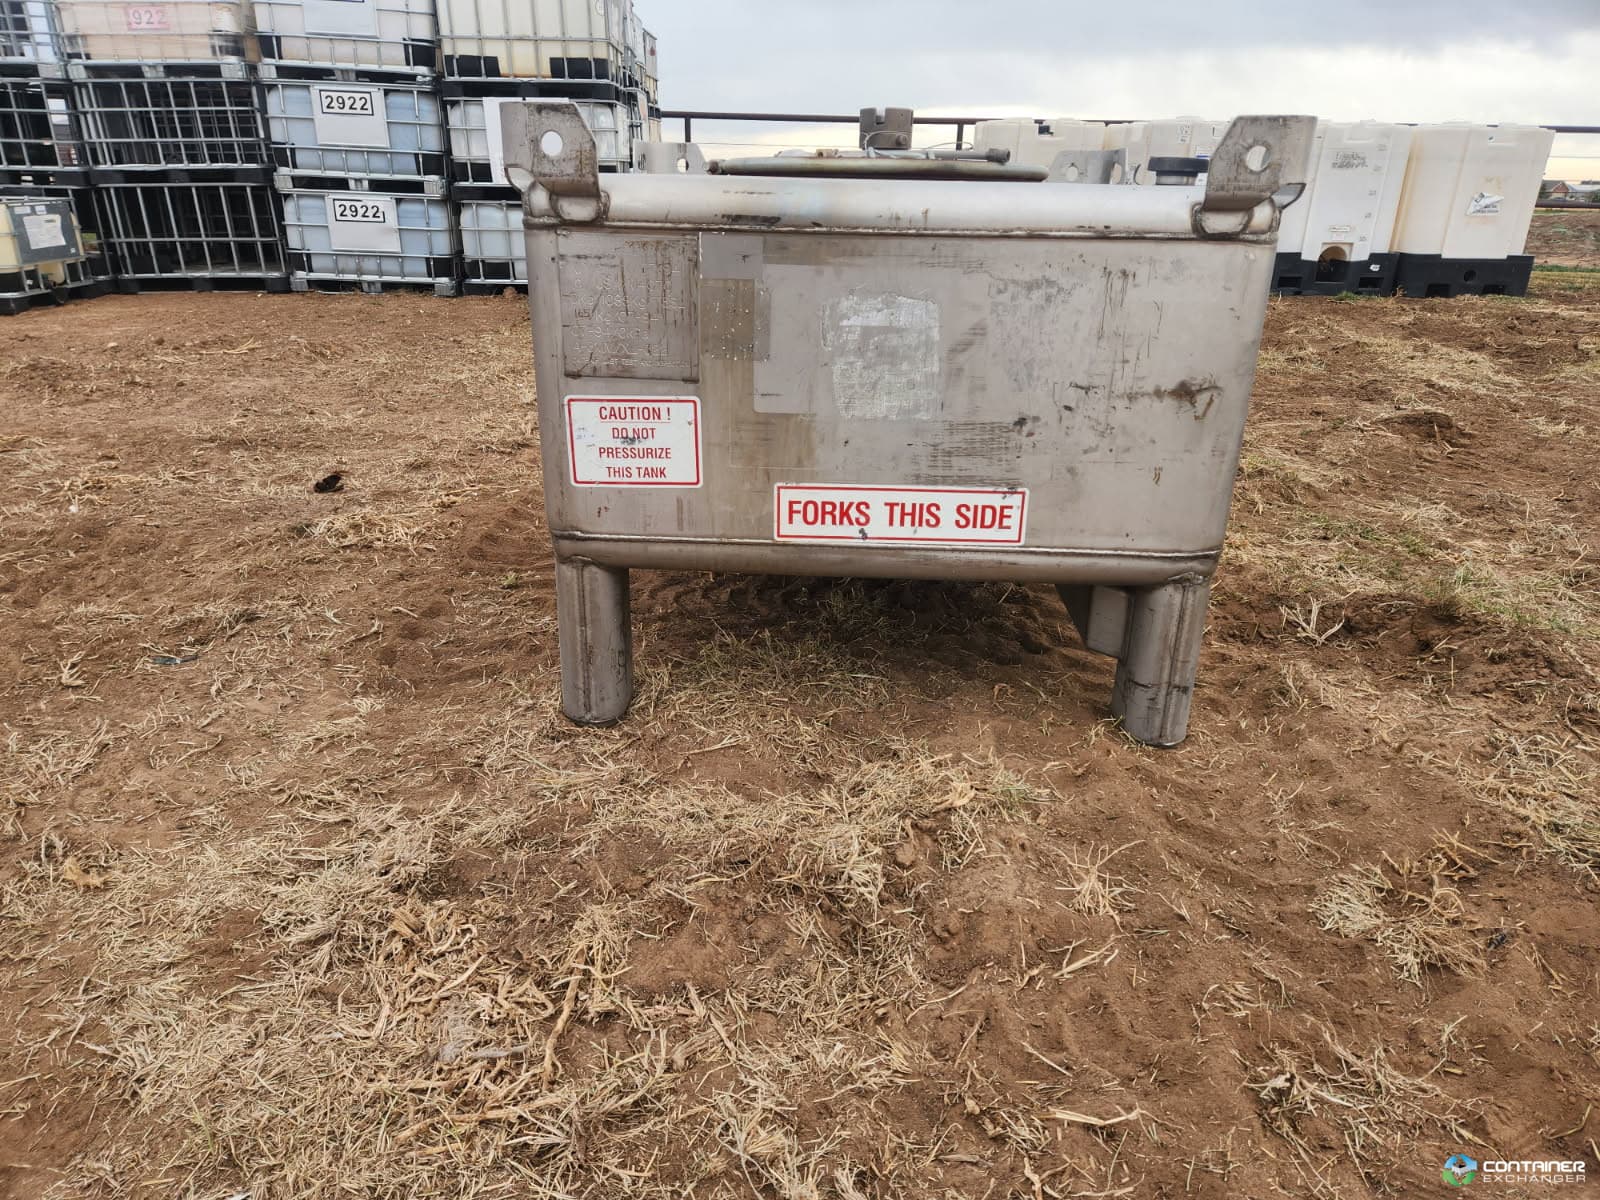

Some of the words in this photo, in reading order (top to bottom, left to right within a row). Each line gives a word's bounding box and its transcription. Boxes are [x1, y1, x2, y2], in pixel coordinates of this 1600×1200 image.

[324, 94, 369, 111] 2922
[338, 203, 381, 219] 2922
[599, 406, 662, 421] CAUTION
[612, 427, 629, 440] DO
[632, 427, 657, 440] NOT
[598, 447, 672, 459] PRESSURIZE
[606, 466, 633, 478] THIS
[635, 466, 667, 479] TANK
[787, 499, 871, 527] FORKS
[884, 501, 941, 528] THIS
[954, 503, 1014, 530] SIDE
